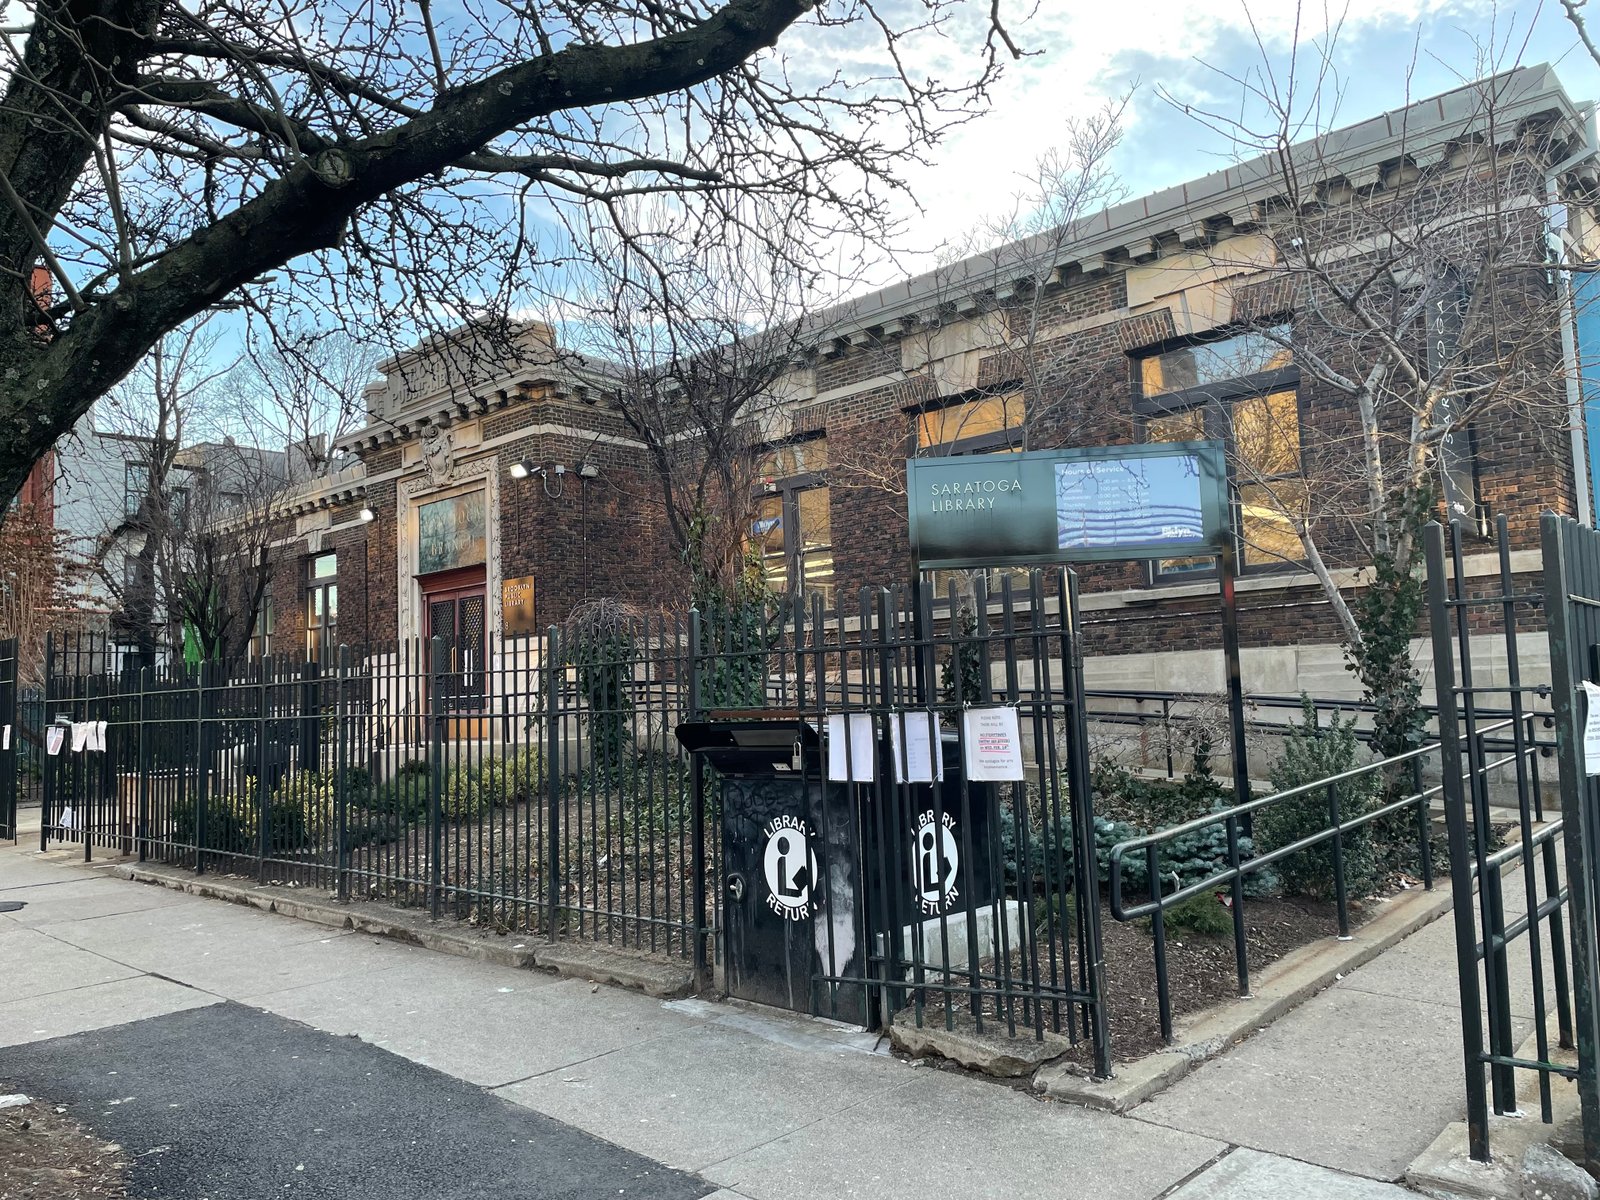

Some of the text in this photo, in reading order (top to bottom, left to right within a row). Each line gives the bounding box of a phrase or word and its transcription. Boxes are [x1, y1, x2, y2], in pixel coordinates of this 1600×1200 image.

[1436, 300, 1454, 445] SAROGA
[931, 479, 1022, 496] SARATOGA
[932, 497, 995, 512] LIBRARY
[765, 893, 818, 922] RETUR
